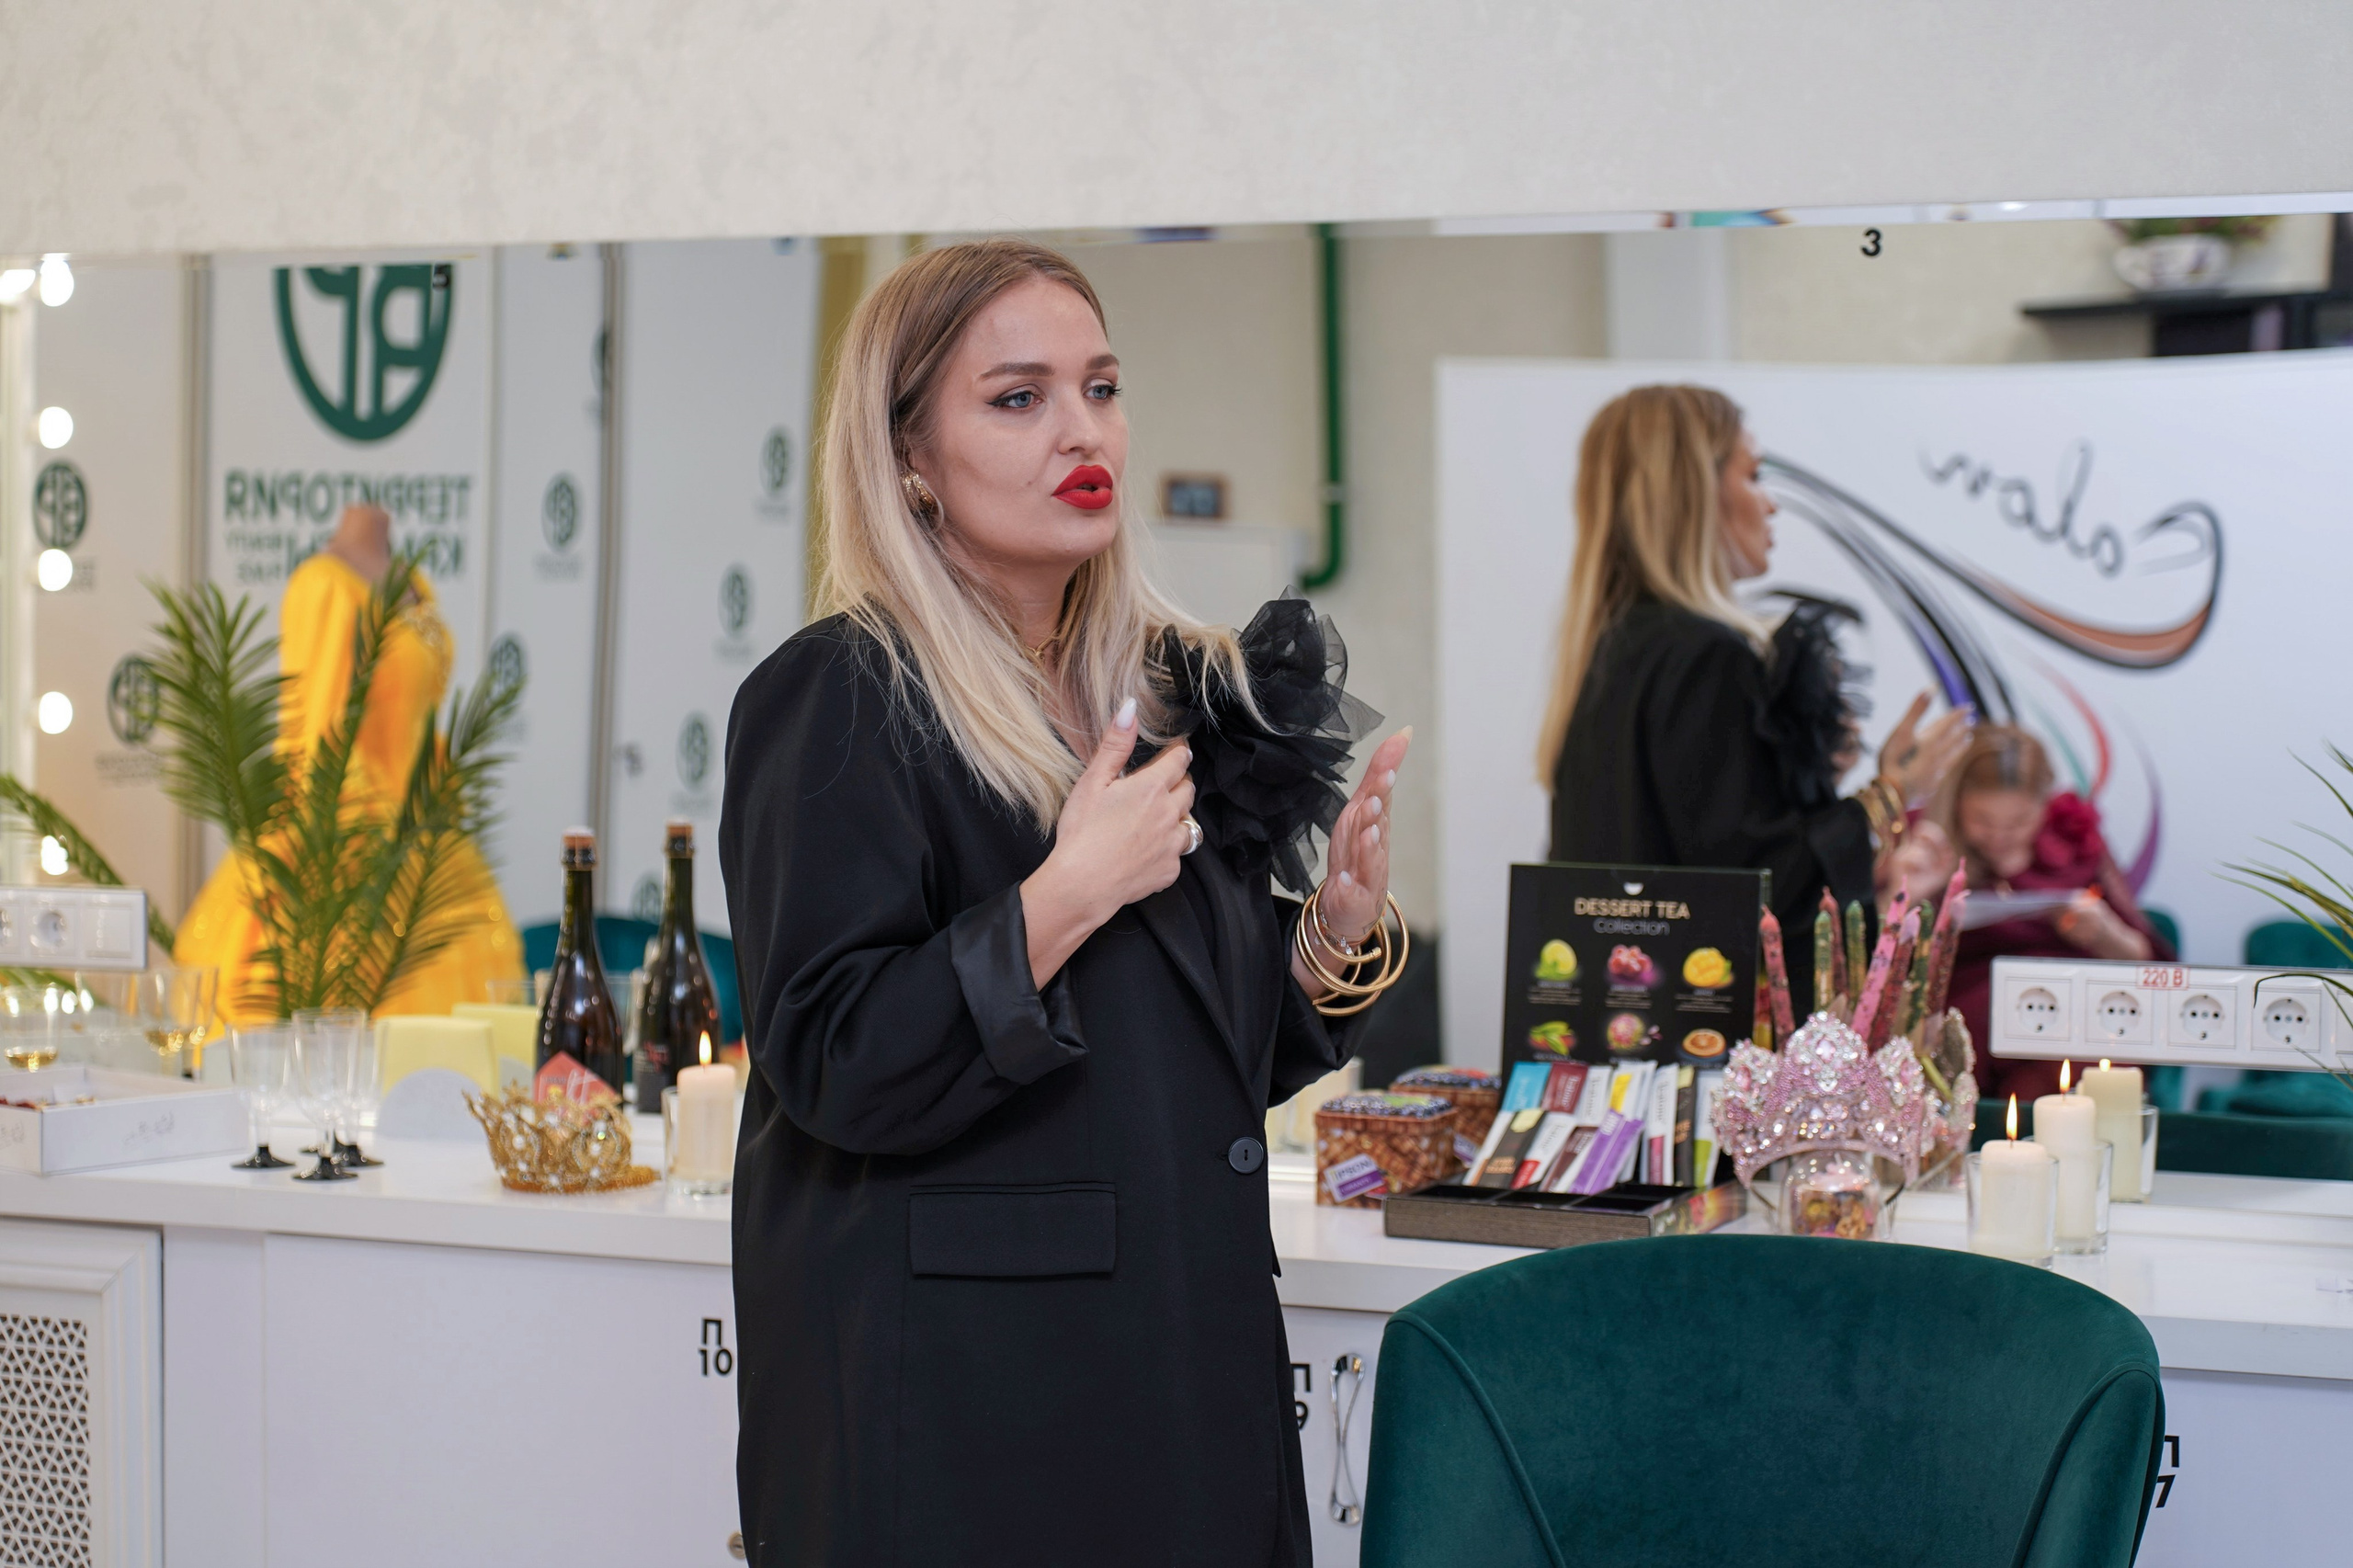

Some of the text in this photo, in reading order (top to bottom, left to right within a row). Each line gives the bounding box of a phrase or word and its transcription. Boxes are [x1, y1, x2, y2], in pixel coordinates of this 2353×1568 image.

[1861, 228, 1881, 257] 3
[1574, 897, 1691, 920] DESSERT TEA
[2143, 967, 2168, 987] 220
[701, 1318, 722, 1346] П
[699, 1347, 733, 1377] 10
